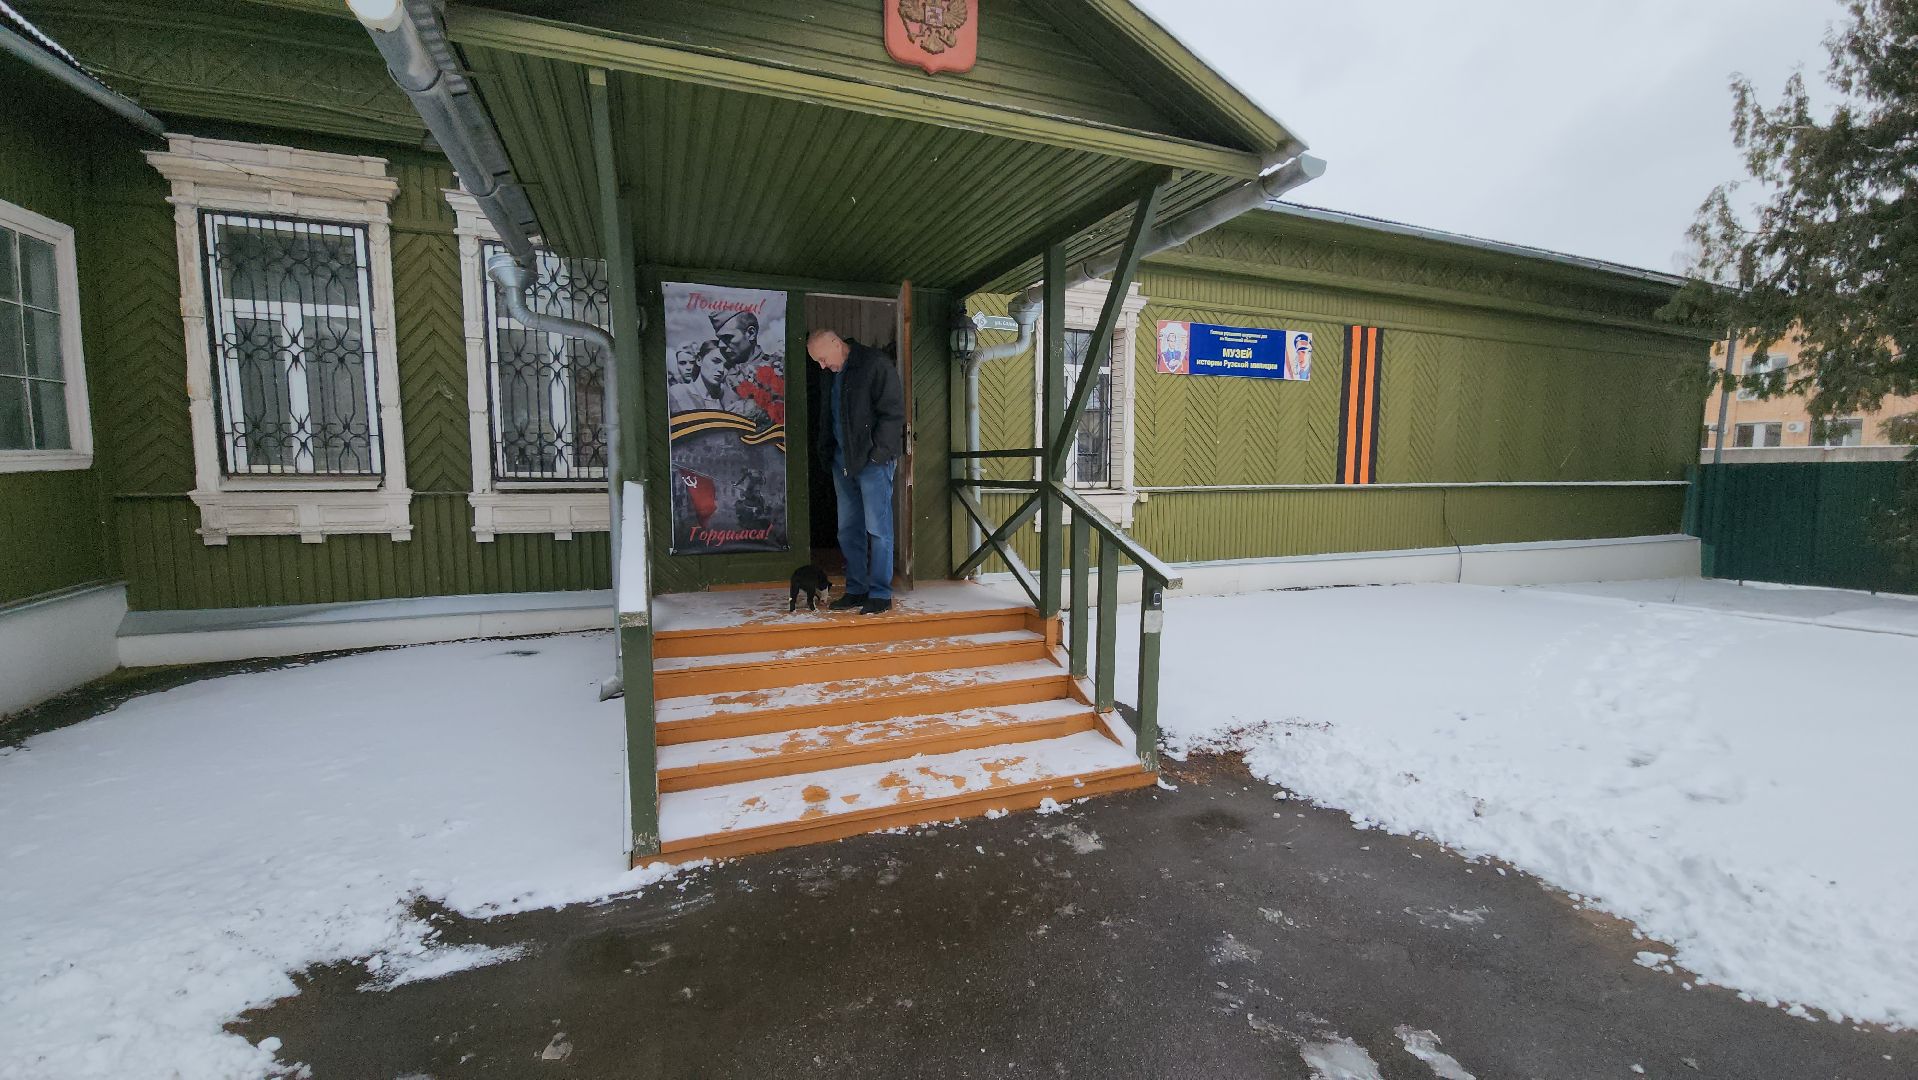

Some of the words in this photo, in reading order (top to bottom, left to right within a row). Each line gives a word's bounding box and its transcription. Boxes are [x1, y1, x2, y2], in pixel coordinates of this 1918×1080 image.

[687, 292, 766, 315] Помним!
[1222, 348, 1252, 359] МУЗЕЙ
[1196, 359, 1222, 368] истории
[1223, 359, 1249, 369] Рузской
[689, 522, 773, 547] Гордимся!
